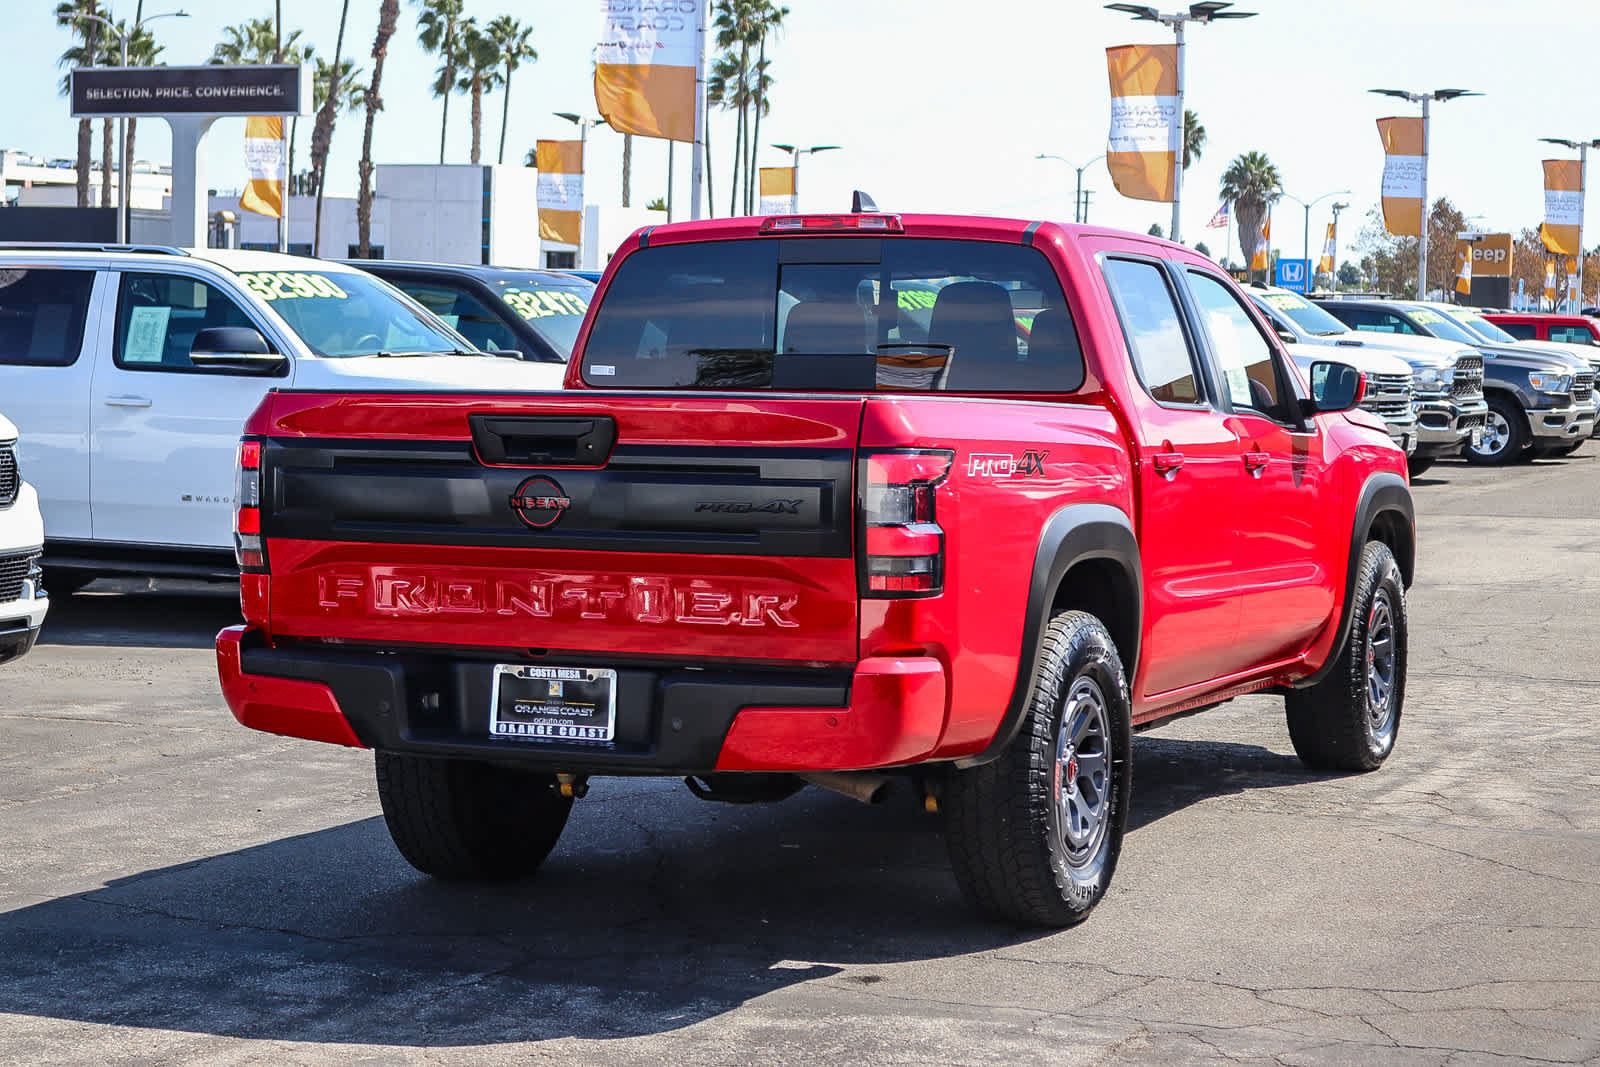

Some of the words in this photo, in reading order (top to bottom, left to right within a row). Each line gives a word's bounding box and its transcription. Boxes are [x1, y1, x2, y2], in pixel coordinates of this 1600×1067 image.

[86, 87, 153, 100] SELECTION.
[155, 87, 193, 98] PRICE.
[195, 85, 285, 97] CONVENIENCE.
[239, 272, 348, 300] 32900
[511, 497, 569, 508] NISSAN
[318, 572, 800, 628] FRONTIER
[529, 668, 556, 678] COSTA
[557, 670, 580, 679] MESA
[514, 704, 560, 715] ORANGE
[560, 706, 595, 717] COAST
[499, 723, 553, 735] ORANGE
[559, 726, 605, 738] COAST
